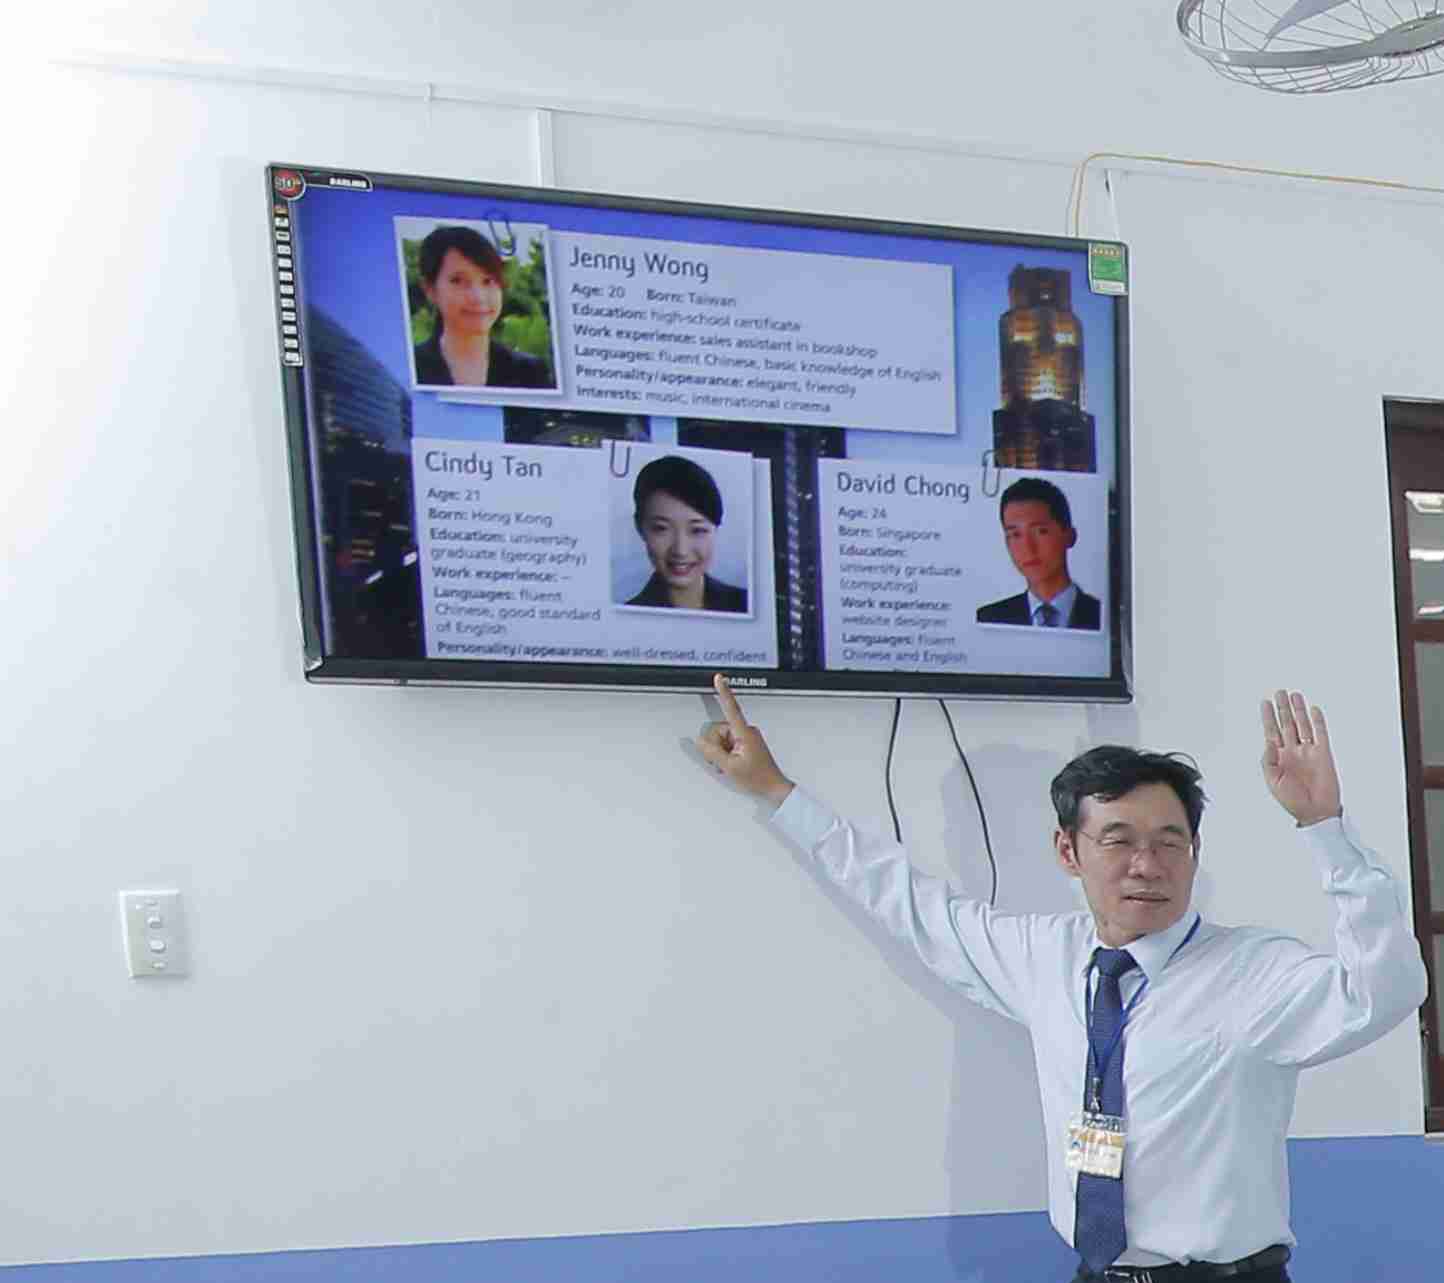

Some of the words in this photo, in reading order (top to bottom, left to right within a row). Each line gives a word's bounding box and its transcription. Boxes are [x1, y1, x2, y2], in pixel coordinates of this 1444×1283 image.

[569, 245, 636, 279] Jenny
[643, 251, 709, 283] Wong
[571, 282, 604, 298] Age:
[608, 285, 626, 299] 20
[647, 288, 684, 304] Born:
[688, 292, 737, 307] Taiwan
[572, 303, 647, 321] Education:
[651, 309, 730, 327] high-school
[733, 315, 801, 331] certificate
[574, 324, 612, 338] Work
[616, 329, 697, 345] experience:
[701, 335, 733, 347] sales
[735, 338, 792, 351] assistant
[796, 341, 810, 352] in
[575, 344, 655, 363] Languages:
[658, 350, 700, 366] fluent
[764, 358, 797, 372] basic
[801, 360, 874, 379] knowledge
[878, 365, 892, 378] of
[895, 367, 942, 383] English
[805, 379, 857, 399] friendly
[576, 385, 641, 401] Interests:
[692, 393, 780, 409] international
[784, 400, 831, 413] cinema
[425, 451, 493, 480] Cindy
[501, 455, 543, 478] Tan
[427, 487, 460, 502] Age:
[464, 490, 480, 501] 21
[837, 472, 896, 494] David
[904, 475, 971, 503] Chong
[428, 508, 468, 521] Born:
[471, 509, 511, 525] Hong
[514, 512, 553, 528] Kong
[838, 506, 868, 521] Age:
[430, 527, 506, 543] Education:
[510, 533, 578, 549] university
[838, 525, 873, 538] Born:
[876, 526, 941, 542] Singapore
[430, 547, 497, 562] graduate
[839, 544, 907, 558] Education:
[431, 566, 470, 580] Work
[475, 568, 558, 583] experience:
[839, 562, 901, 577] university
[904, 564, 962, 578] graduate
[434, 586, 514, 602] Languages:
[840, 597, 875, 609] Work
[499, 607, 536, 622] good
[539, 607, 601, 621] standard
[436, 621, 451, 633] of
[456, 621, 507, 637] English
[895, 650, 919, 662] and
